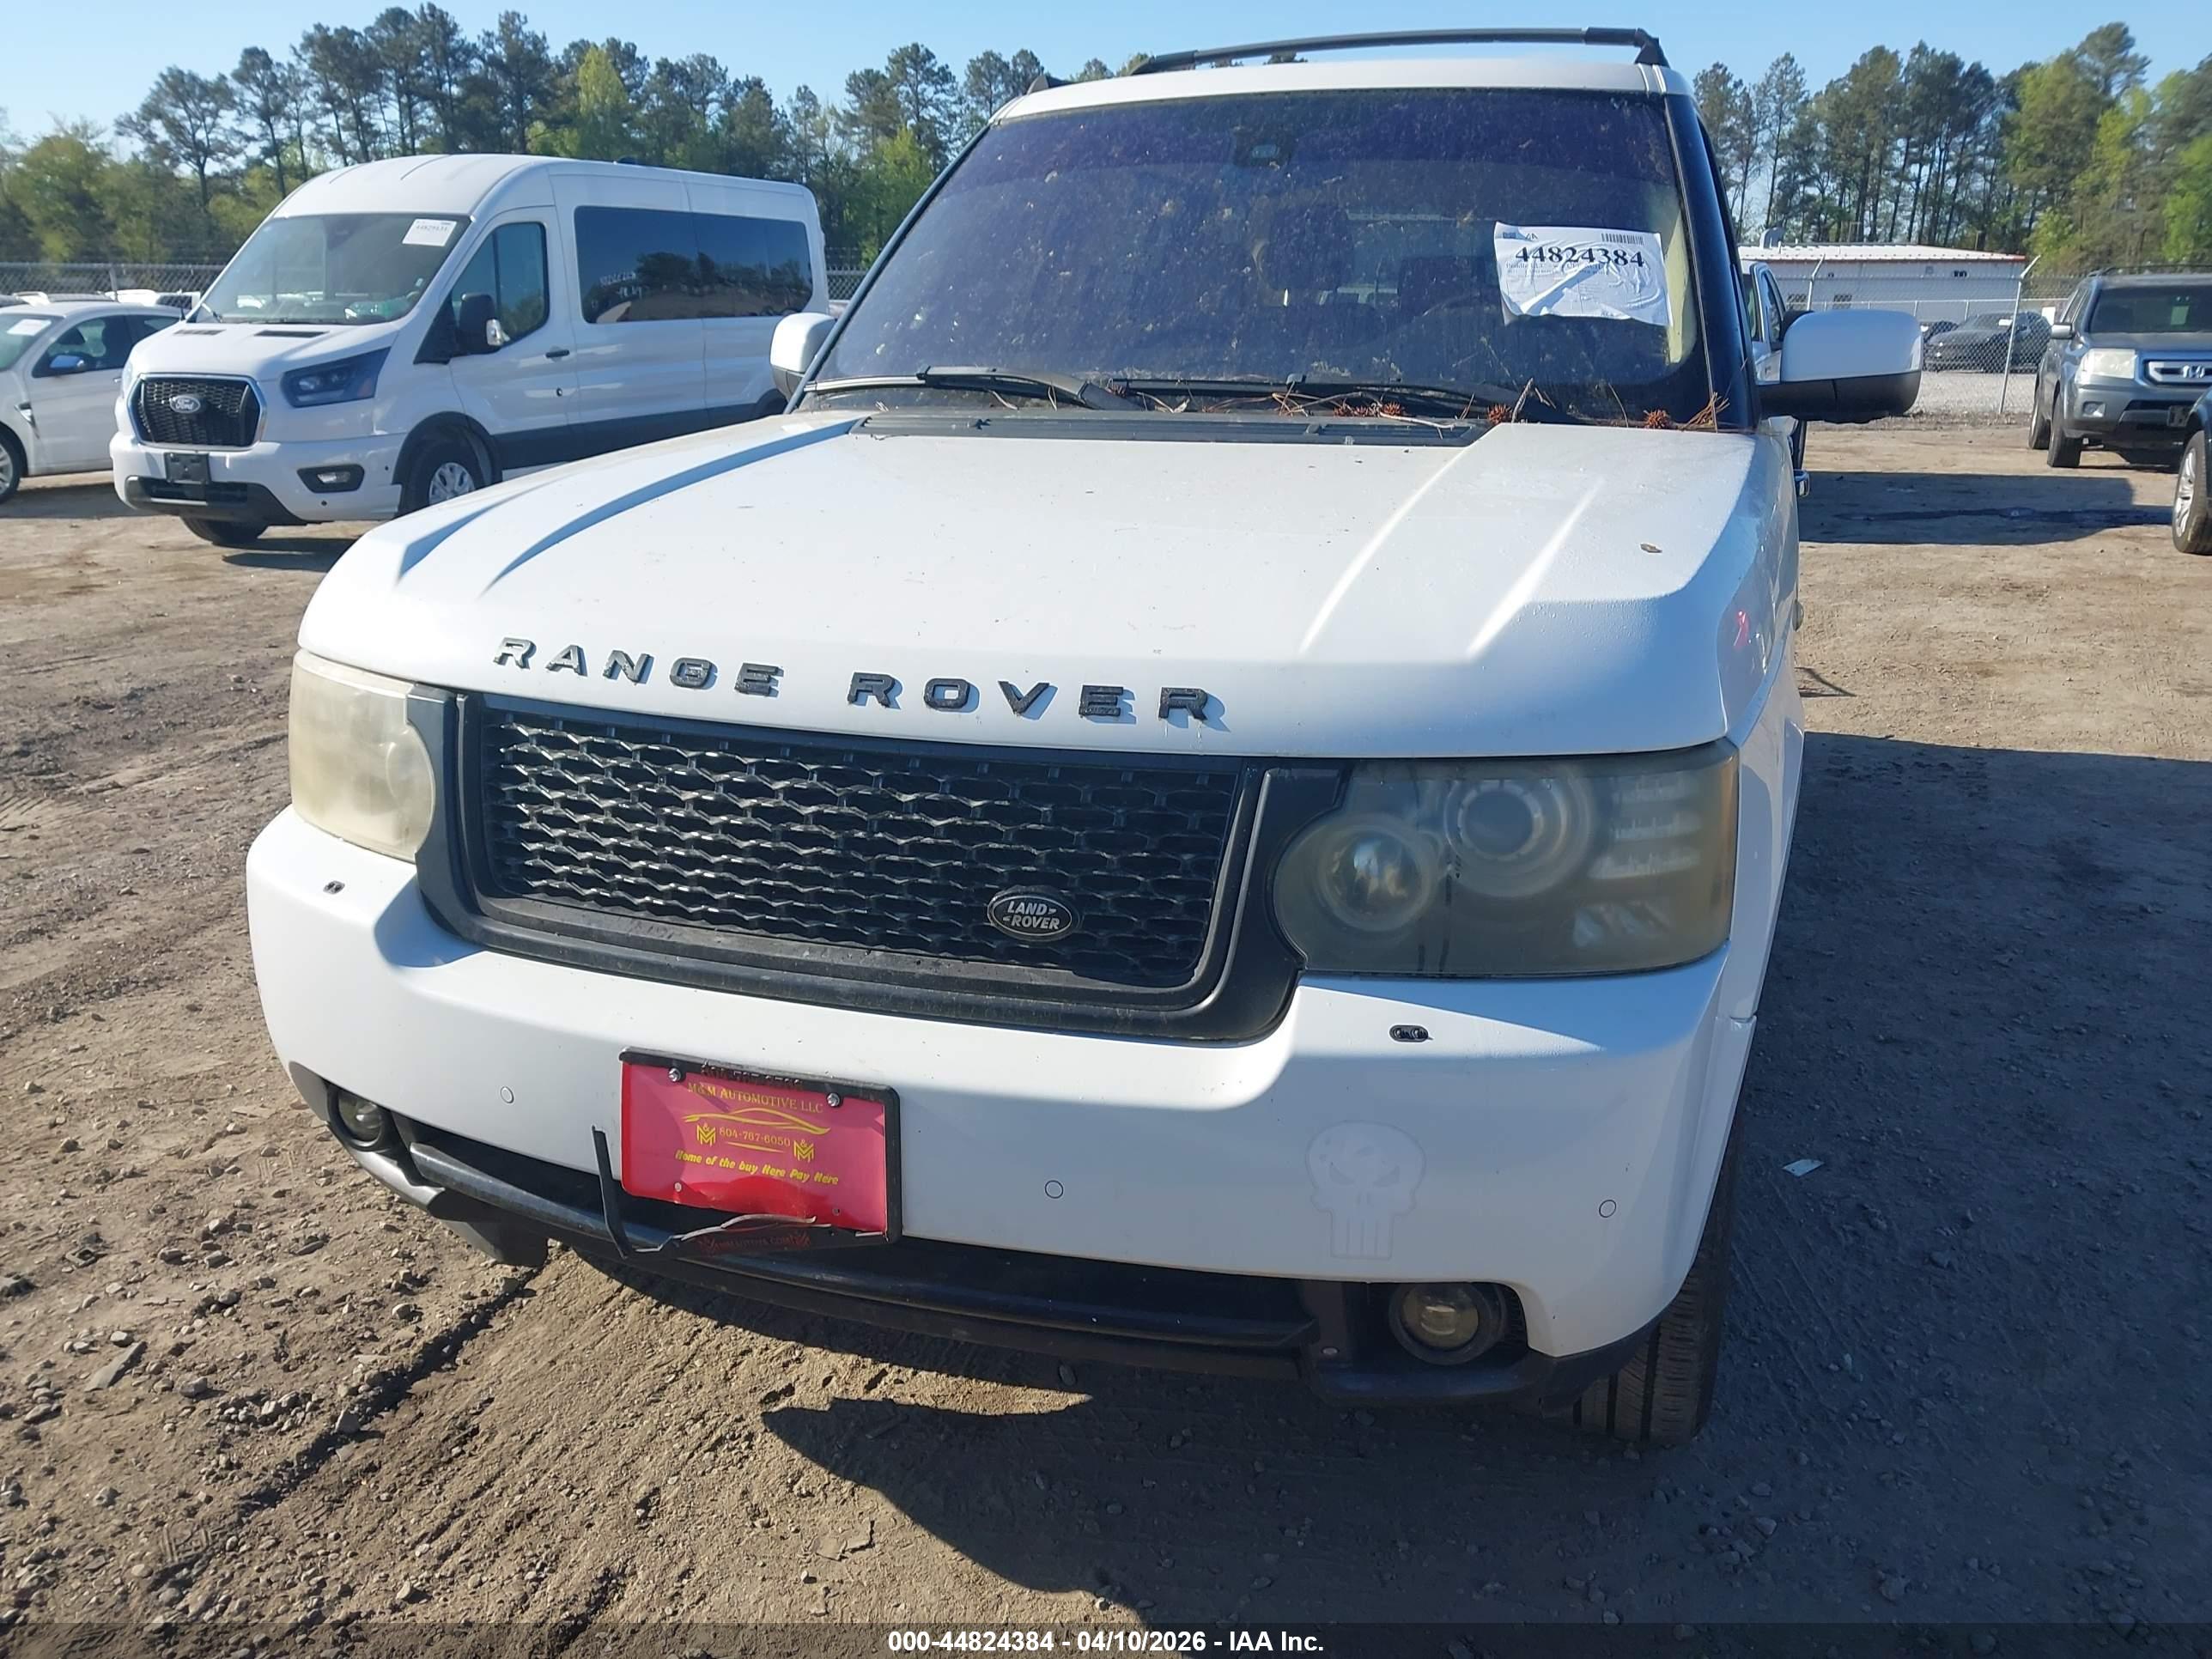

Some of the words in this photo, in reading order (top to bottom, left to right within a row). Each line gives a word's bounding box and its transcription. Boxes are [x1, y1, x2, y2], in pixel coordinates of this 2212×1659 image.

[1516, 246, 1645, 268] 44824384
[493, 637, 780, 697] RANGE
[847, 672, 1209, 721] ROVER
[1007, 901, 1048, 915] LAND
[1011, 915, 1060, 930] ROVER
[688, 1082, 716, 1096] M&M
[720, 1088, 797, 1109] AUTOMOTIVE
[801, 1101, 823, 1114] LLC
[675, 1150, 702, 1163] Home
[705, 1154, 717, 1165] of
[719, 1156, 736, 1169] the
[738, 1160, 759, 1175] buy
[762, 1164, 785, 1177] Here
[789, 1168, 811, 1182] Pay
[813, 1171, 839, 1185] Here
